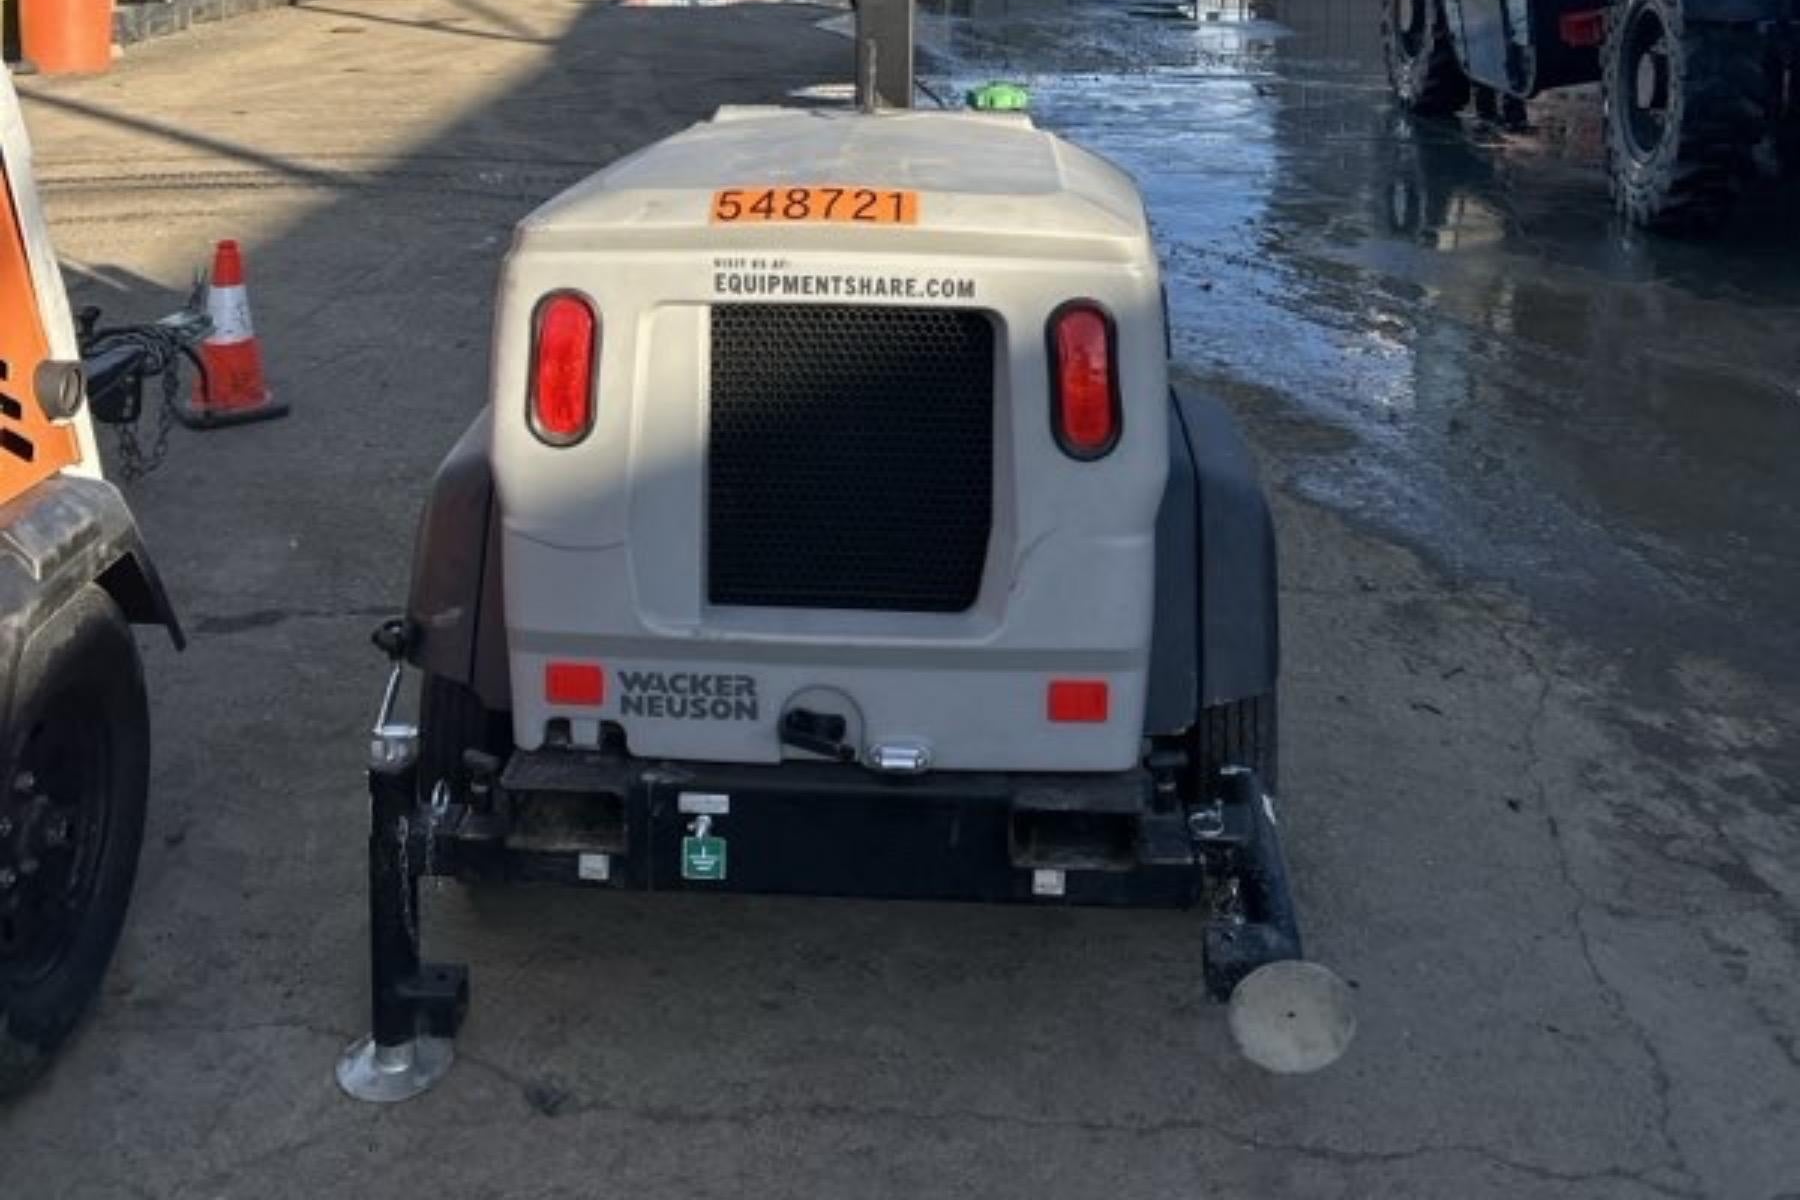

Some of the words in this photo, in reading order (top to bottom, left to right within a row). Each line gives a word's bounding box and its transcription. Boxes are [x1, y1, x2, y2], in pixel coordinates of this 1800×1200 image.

[716, 188, 905, 222] 548721
[714, 273, 976, 298] EQUIPMENTSHARE.COM
[618, 671, 757, 697] WACKER
[620, 696, 759, 721] NEUSON
